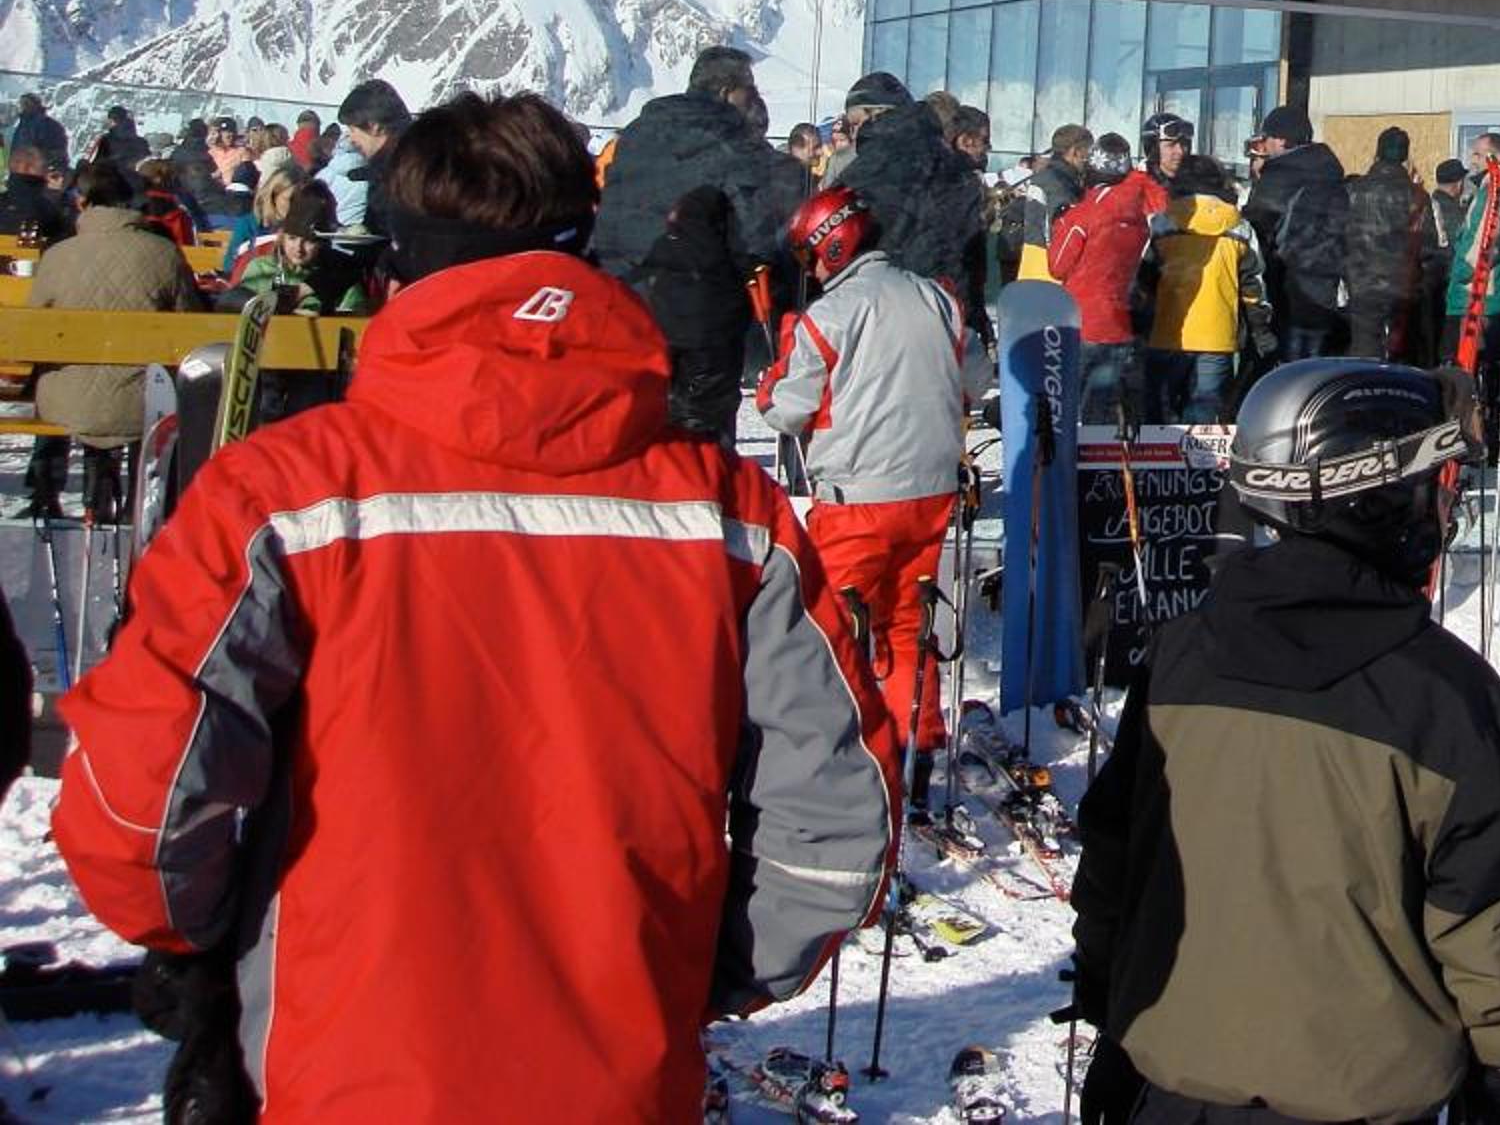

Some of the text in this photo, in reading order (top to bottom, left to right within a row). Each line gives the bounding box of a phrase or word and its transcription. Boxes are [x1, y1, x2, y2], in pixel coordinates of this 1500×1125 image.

[808, 204, 854, 246] uvex
[227, 299, 270, 442] ISCHER
[1085, 469, 1225, 502] ERFNUNGS
[1246, 452, 1397, 489] CARRERA
